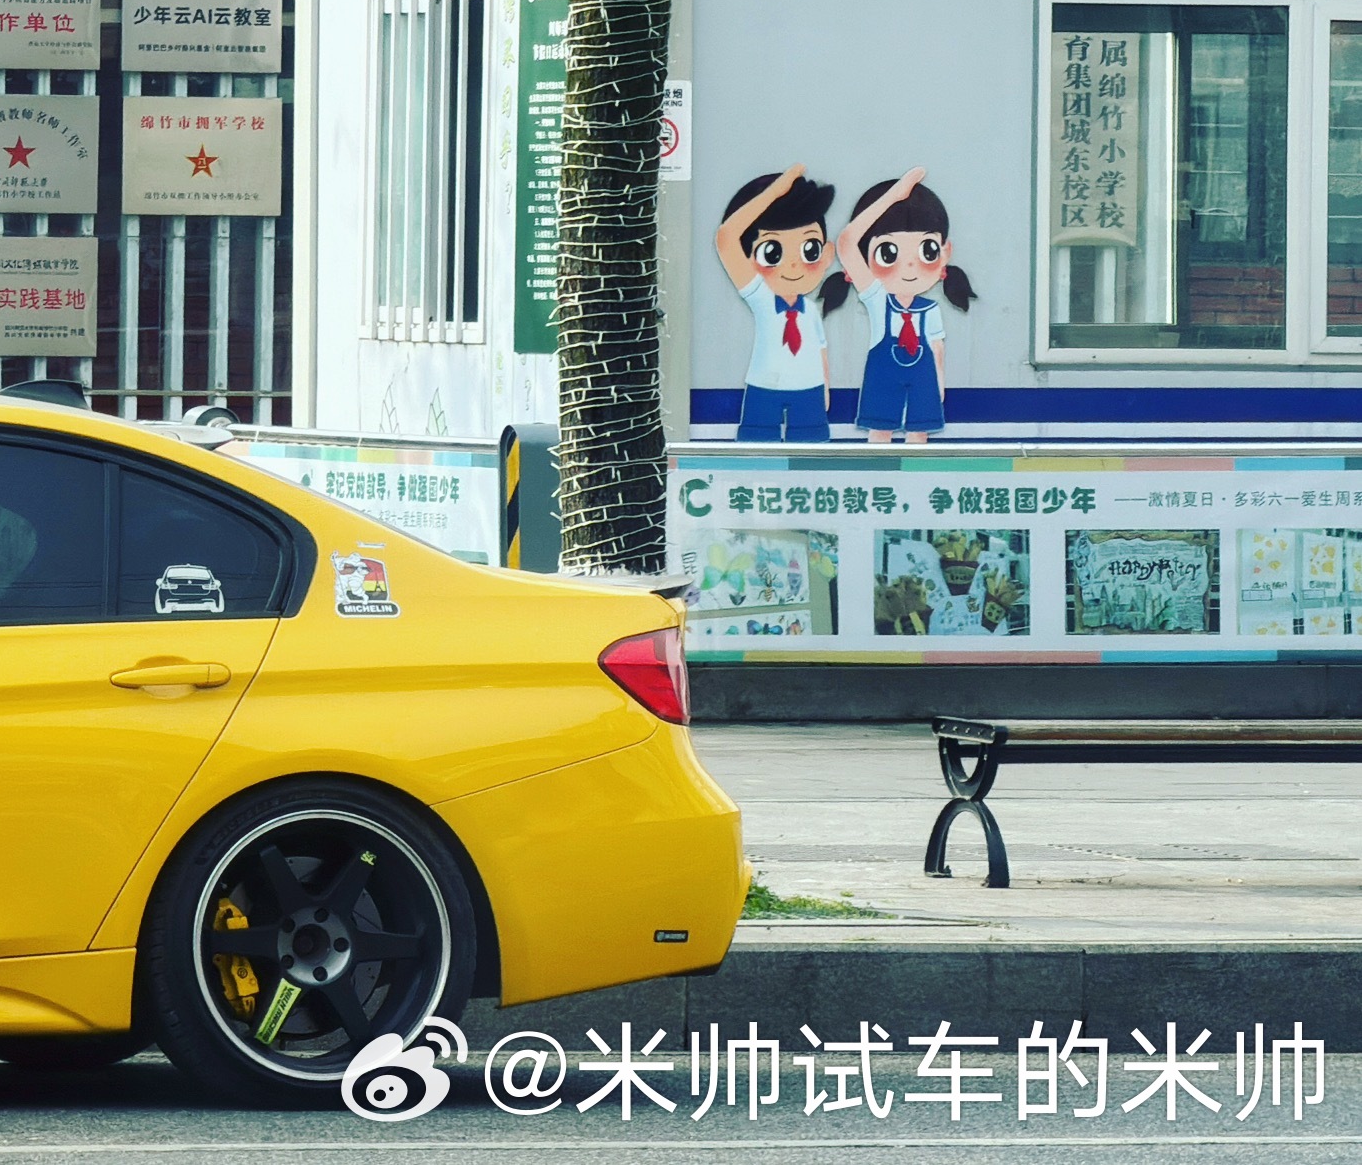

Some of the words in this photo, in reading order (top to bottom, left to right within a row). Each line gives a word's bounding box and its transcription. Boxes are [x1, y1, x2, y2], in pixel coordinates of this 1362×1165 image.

[133, 5, 272, 27] 少年云AI云教室
[140, 115, 266, 131] 绵竹市拥军学校
[1060, 34, 1092, 229] 育集团城东校区
[1095, 38, 1128, 231] 属绵竹小学校
[343, 603, 394, 615] MICHELIN
